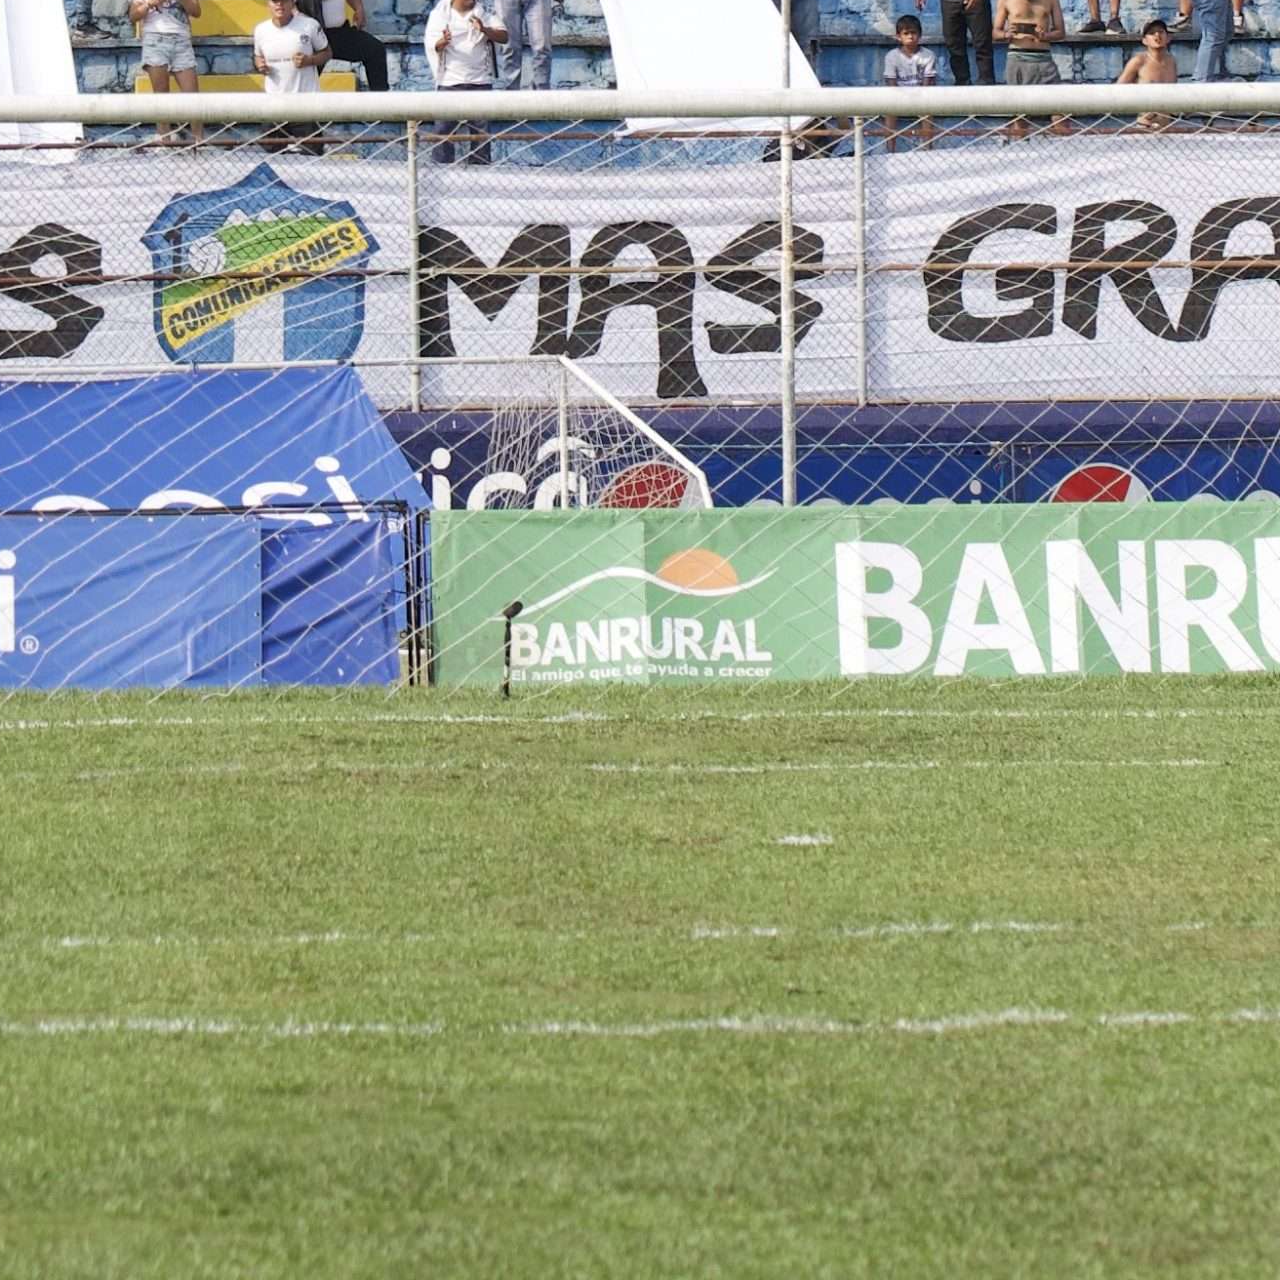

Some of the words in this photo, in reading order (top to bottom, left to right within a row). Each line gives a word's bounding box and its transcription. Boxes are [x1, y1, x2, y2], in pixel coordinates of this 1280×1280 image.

[418, 220, 827, 398] MAS
[511, 616, 772, 667] BANRURAL
[511, 671, 527, 682] El
[532, 668, 585, 683] amigo
[590, 668, 620, 681] que
[625, 664, 643, 676] te
[648, 663, 699, 680] ayuda
[704, 667, 714, 677] a
